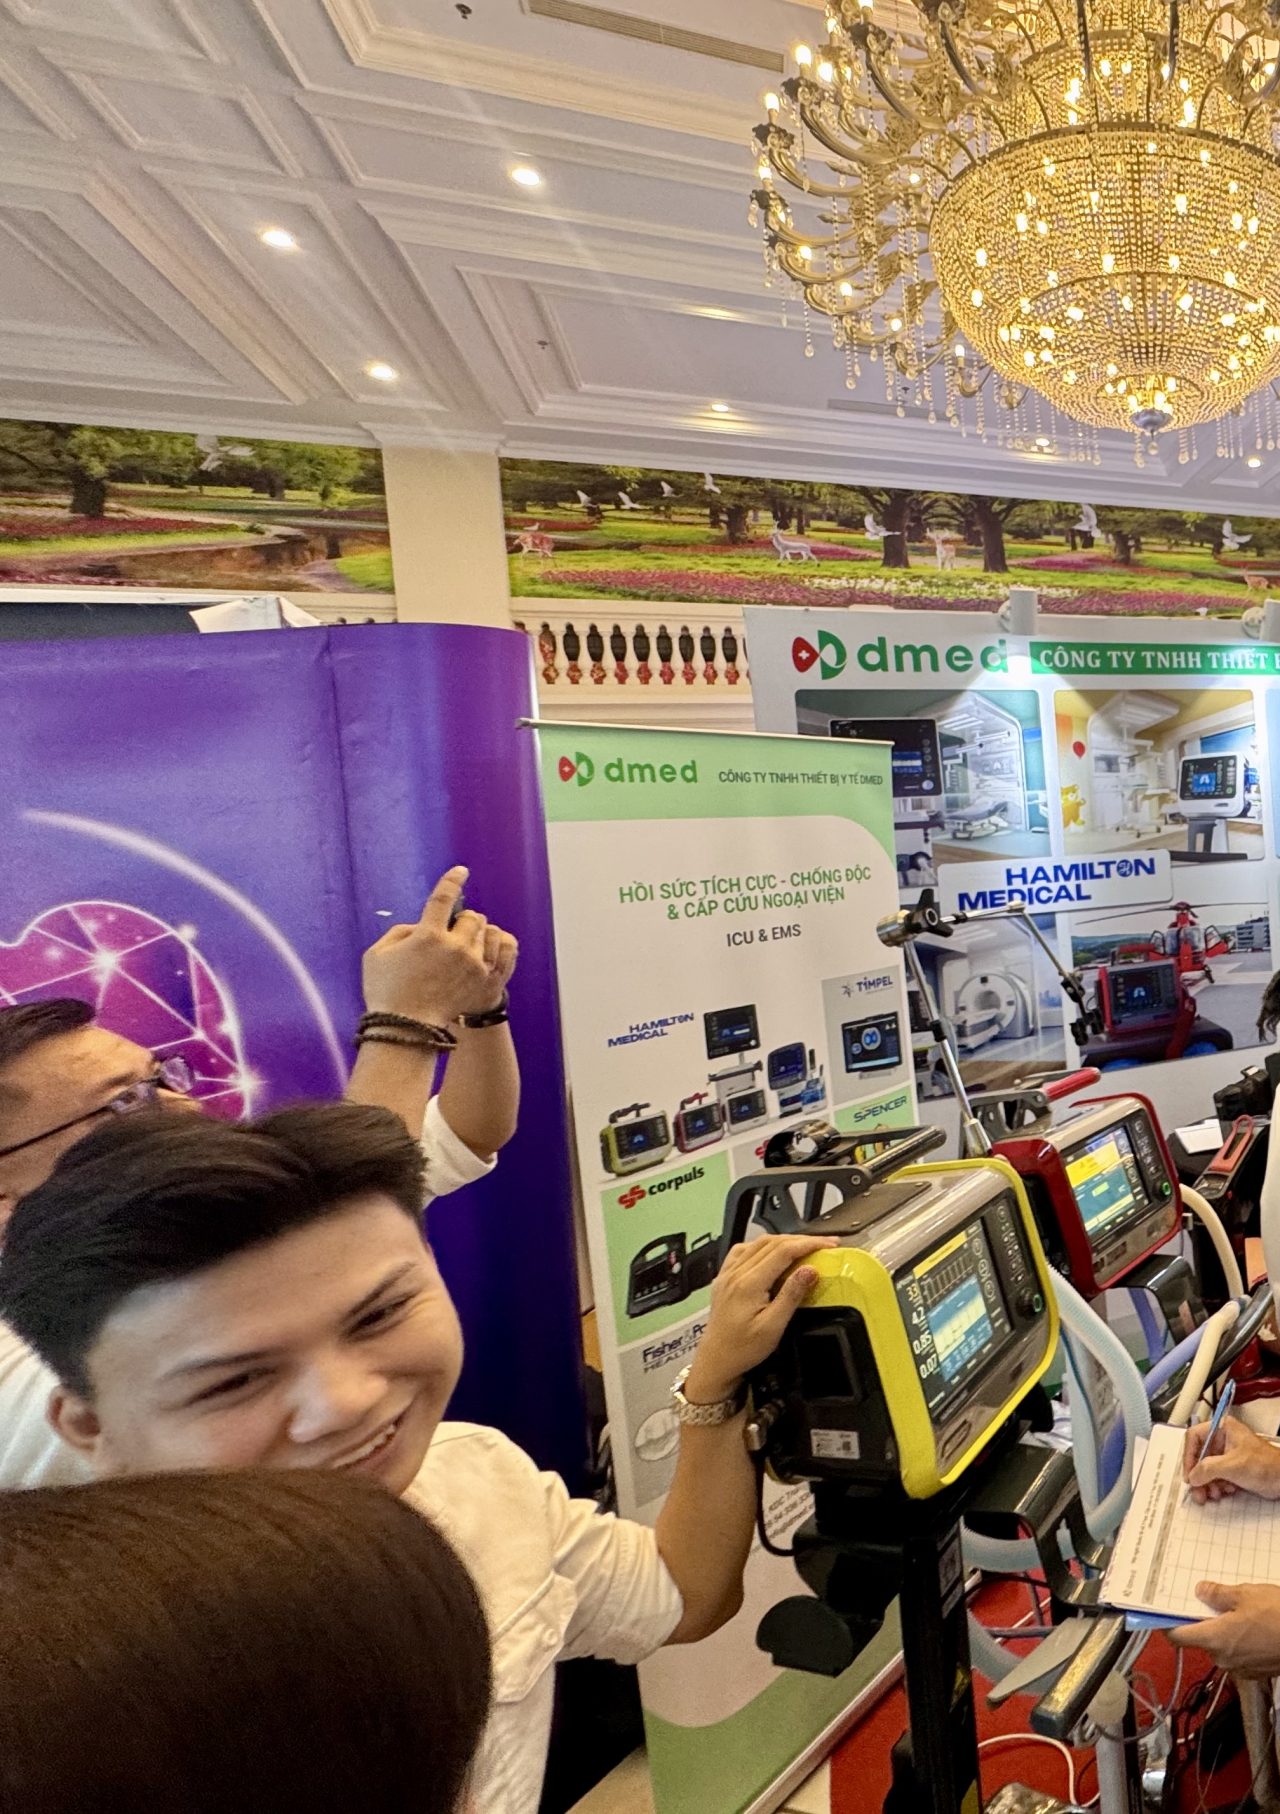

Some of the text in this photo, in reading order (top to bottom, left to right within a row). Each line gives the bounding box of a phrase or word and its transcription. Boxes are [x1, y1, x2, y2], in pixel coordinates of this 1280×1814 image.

[857, 636, 1008, 673] dmed
[1039, 645, 1101, 668] CÔNG
[1107, 651, 1135, 669] TY
[1141, 651, 1202, 669] TNHH
[1207, 648, 1269, 669] THIẾT
[604, 757, 698, 783] dmed
[718, 768, 751, 783] CÔNG
[753, 771, 767, 784] TY
[768, 772, 799, 784] TNHH
[800, 770, 828, 784] THIẾT
[830, 773, 840, 787] BỊ
[840, 773, 847, 784] Y
[860, 775, 883, 785] DMED
[618, 879, 654, 903] HỒI
[659, 877, 696, 900] SỨC
[700, 873, 742, 897] TÍCH
[745, 873, 777, 894] CỰC
[790, 865, 842, 887] CHỐNG
[845, 863, 872, 884] ĐỘC
[1006, 857, 1155, 886] HAMILTON
[667, 886, 845, 920] & CẤP CỨU NGOẠI VIỆN
[958, 883, 1091, 911] MEDICAL
[726, 924, 802, 947] ICU & EMS
[629, 1012, 694, 1034] HAMILTON
[608, 1028, 668, 1047] MEDICAL
[853, 1095, 907, 1123] SPENCER
[648, 1166, 705, 1195] corpuls
